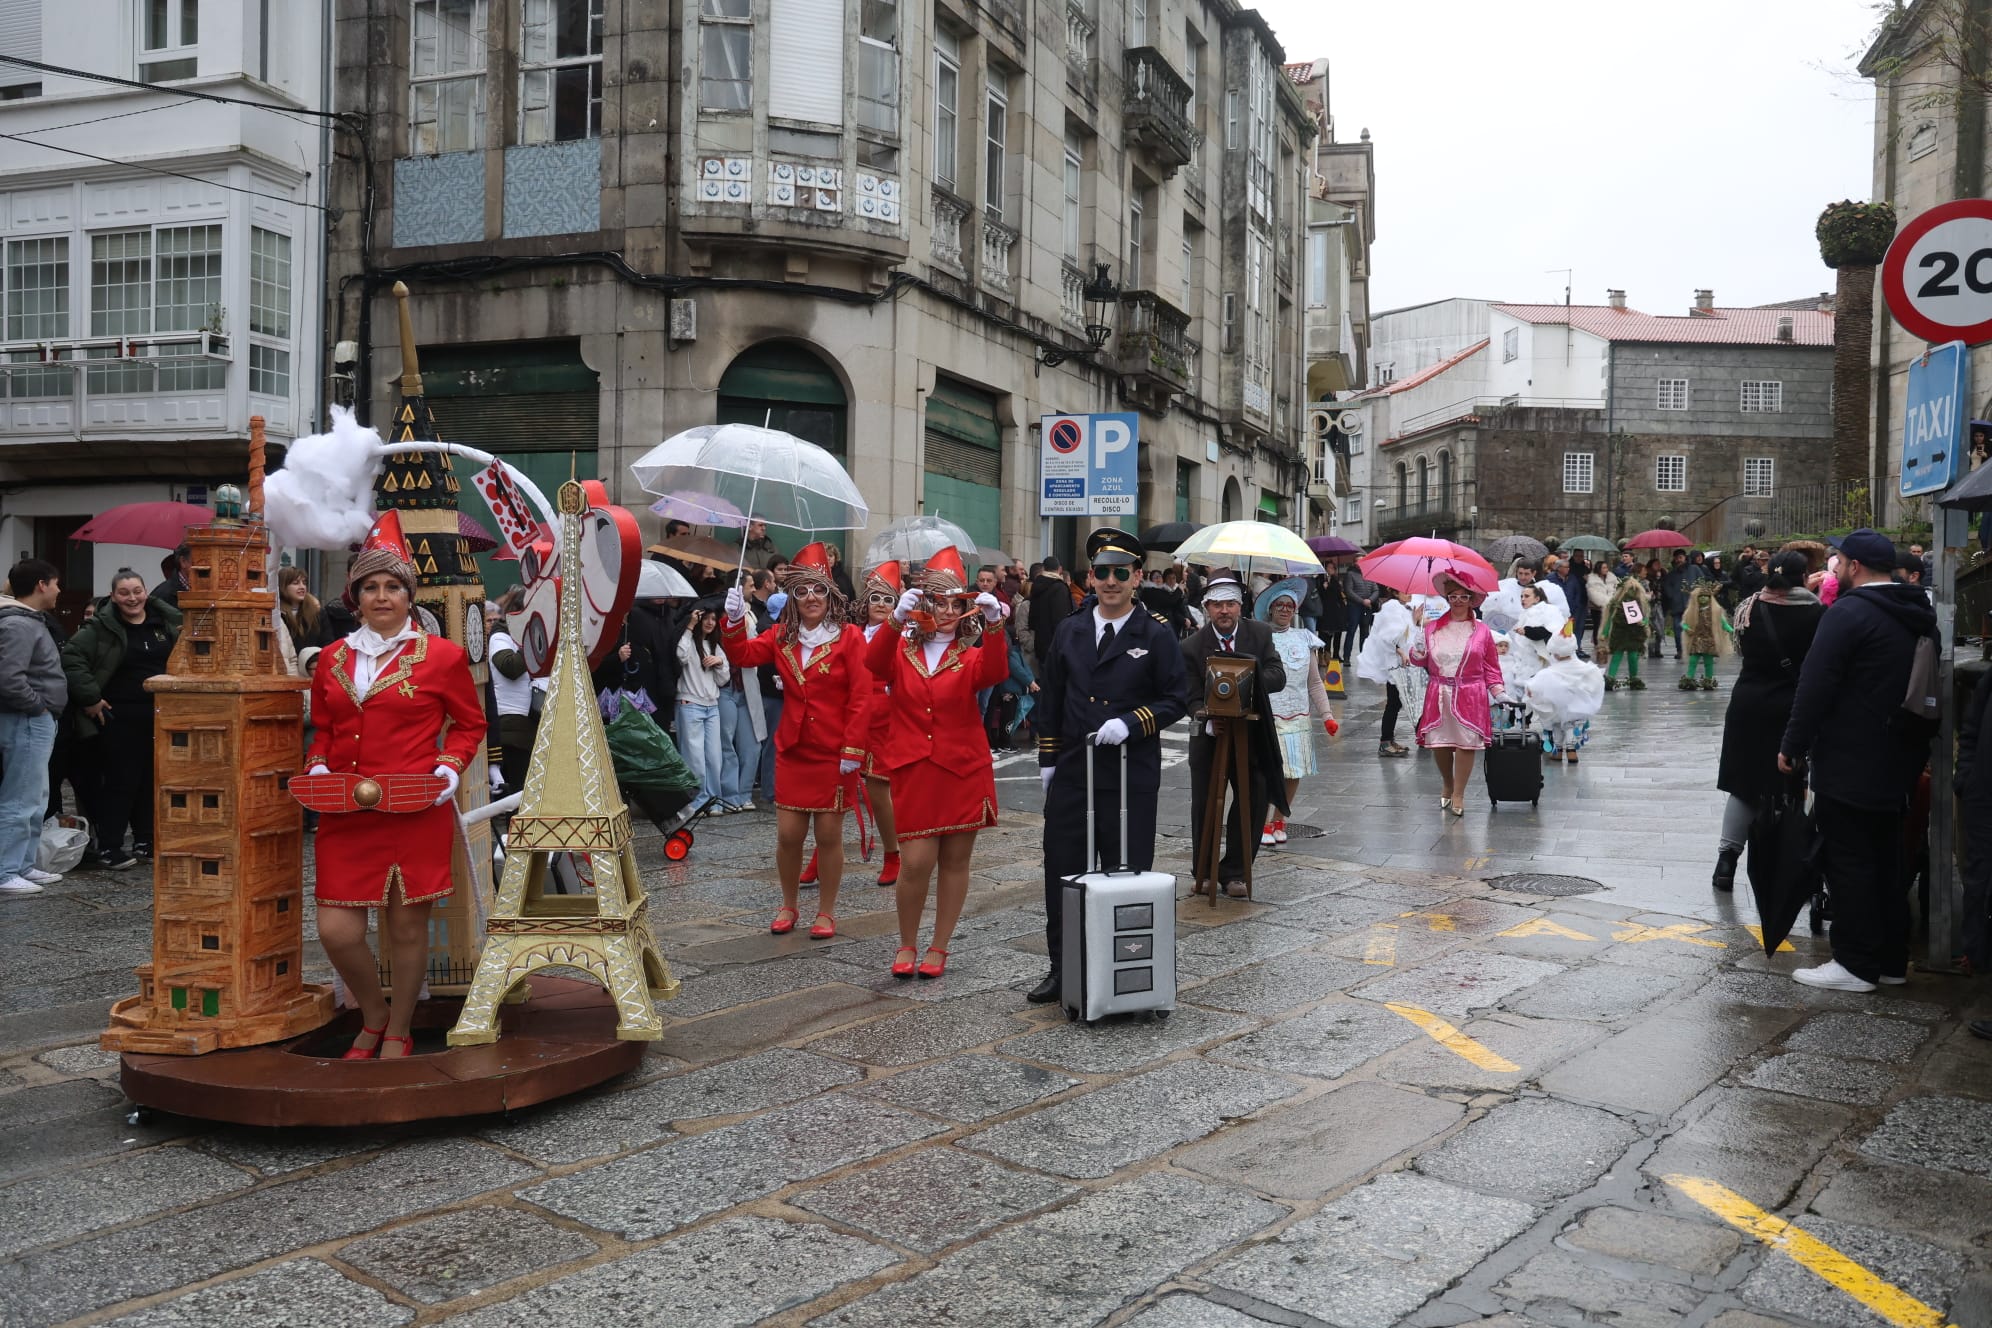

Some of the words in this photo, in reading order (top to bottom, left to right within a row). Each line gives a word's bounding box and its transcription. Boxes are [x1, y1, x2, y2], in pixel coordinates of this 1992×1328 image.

[1917, 248, 1992, 297] 20
[1908, 396, 1951, 447] TAXI
[1095, 420, 1131, 469] P
[1093, 496, 1130, 504] RECOLLE-LO
[1102, 505, 1121, 513] DISCO
[1627, 605, 1638, 618] 5
